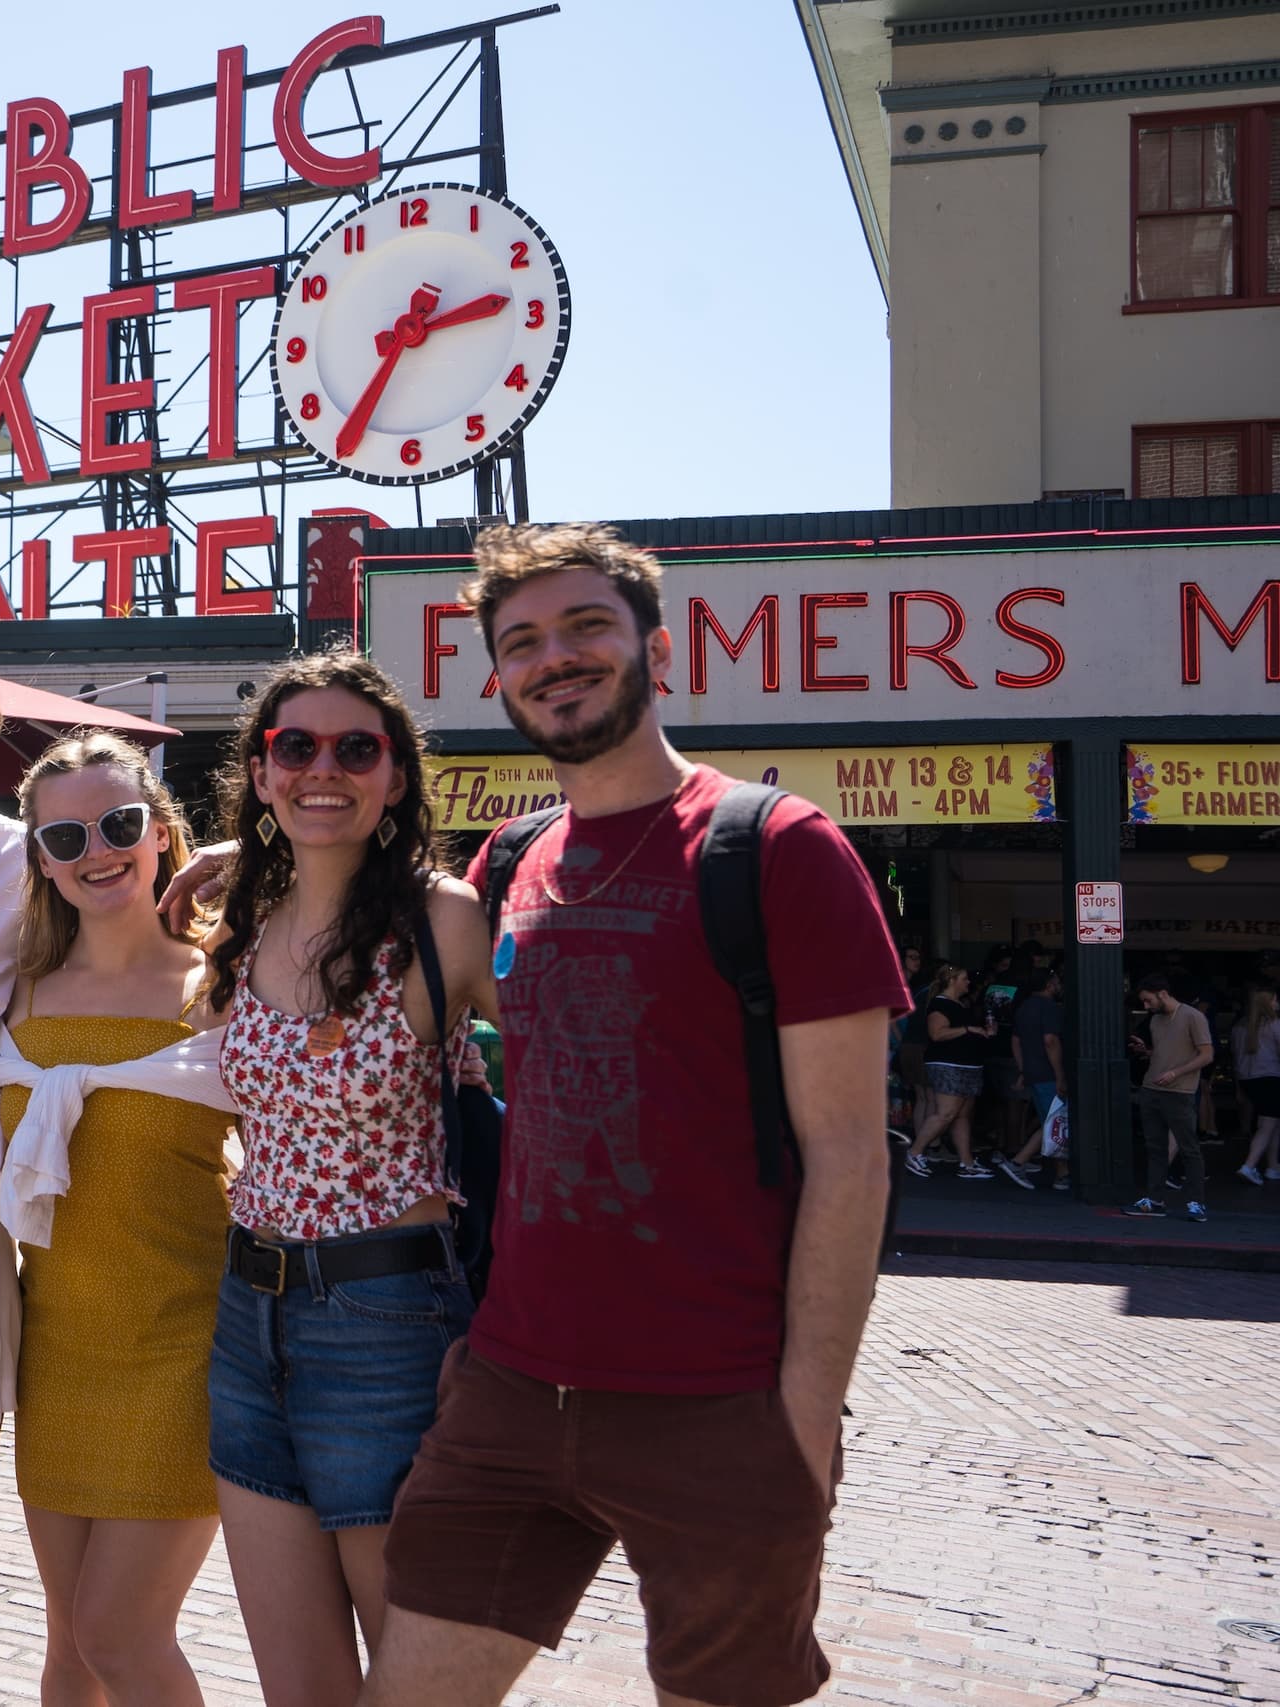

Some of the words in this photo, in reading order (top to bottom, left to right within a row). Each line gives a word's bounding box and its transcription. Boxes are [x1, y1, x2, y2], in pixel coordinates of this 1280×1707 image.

[400, 199, 429, 228] 12
[469, 205, 479, 233] 1
[344, 225, 365, 255] 11
[510, 241, 530, 269] 2
[302, 275, 327, 303] 10
[525, 300, 545, 329] 3
[286, 337, 307, 363] 9
[504, 364, 529, 392] 4
[300, 393, 321, 421] 8
[465, 415, 486, 442] 5
[400, 439, 422, 466] 6
[424, 587, 1065, 699] FMERS
[494, 768, 521, 782] 15TH
[527, 768, 557, 782] ANN
[836, 757, 895, 788] MAY
[908, 757, 937, 787] 13
[947, 756, 974, 786] &
[985, 755, 1013, 785] 14
[1161, 761, 1205, 786] 35+
[839, 790, 898, 817] 11AM
[935, 788, 990, 816] 4PM
[1182, 791, 1280, 816] FARMER
[588, 879, 694, 913] MARKET
[1079, 885, 1092, 894] NO
[1082, 897, 1116, 907] STOPS
